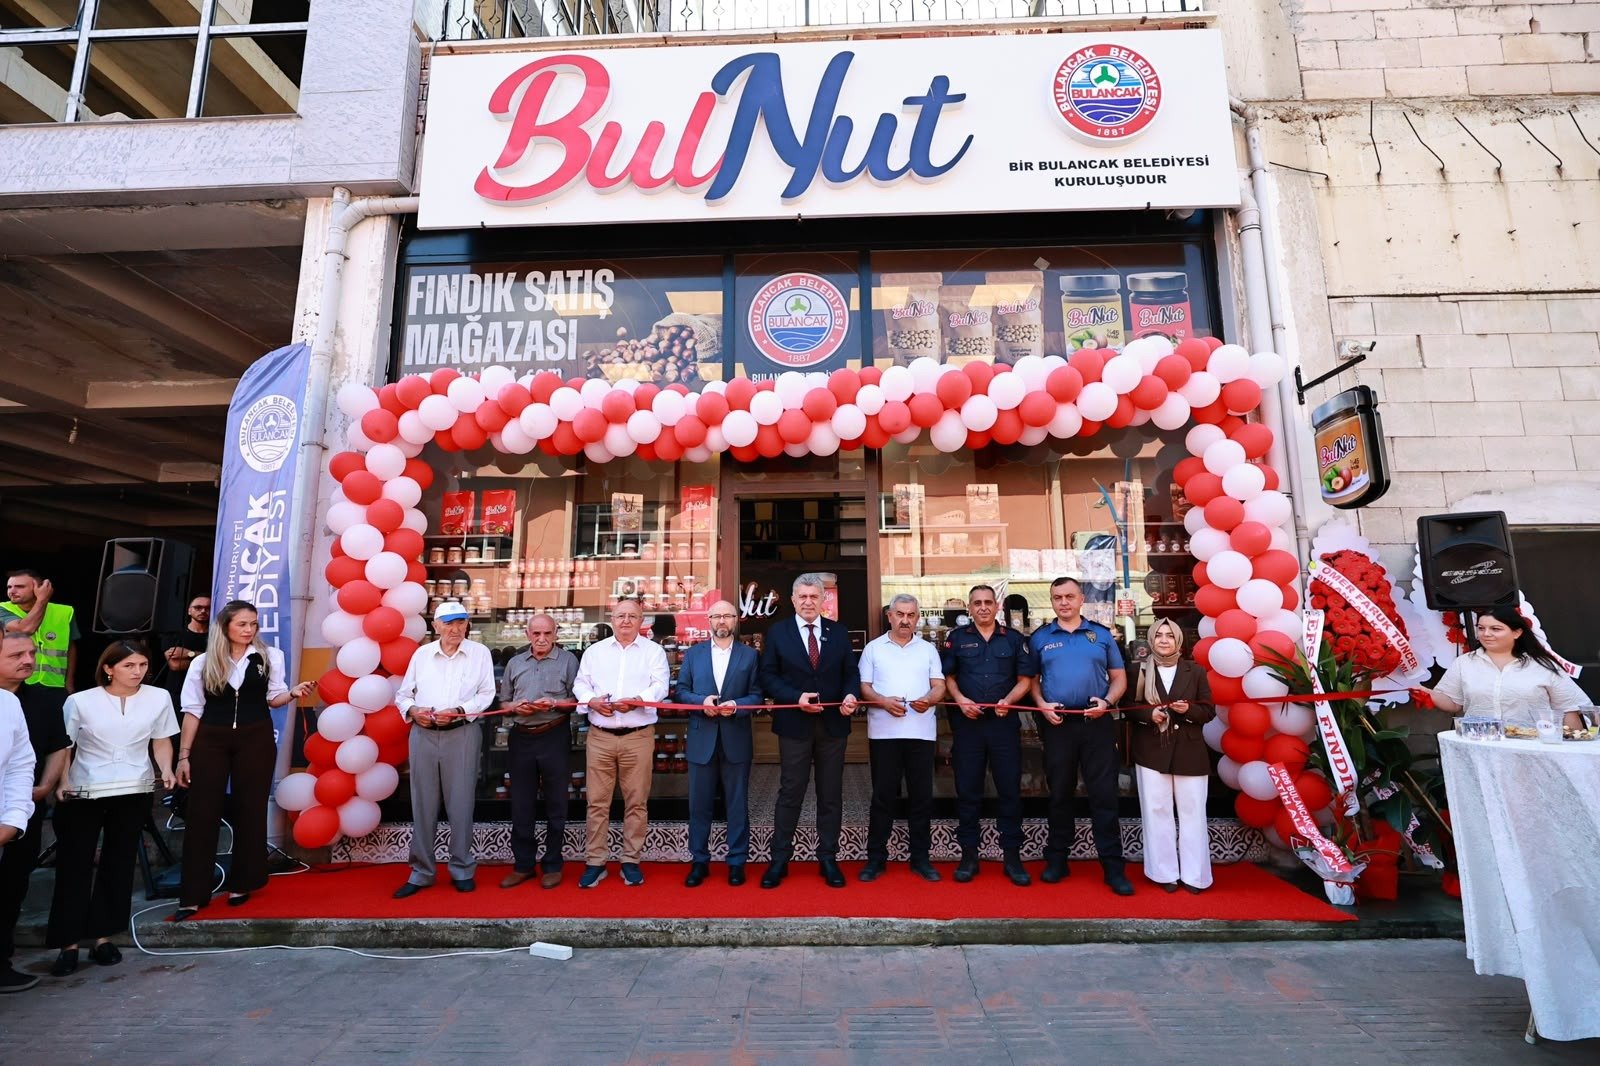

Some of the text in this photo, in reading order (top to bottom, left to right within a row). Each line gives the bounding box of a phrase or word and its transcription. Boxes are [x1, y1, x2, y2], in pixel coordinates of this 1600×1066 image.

[1055, 47, 1098, 112] BULANCAK
[1071, 86, 1142, 99] BULANCAK
[473, 50, 976, 206] BulNut
[1096, 127, 1126, 136] 1887
[1008, 154, 1210, 171] BİR BULANCAK BELEDİYESİ
[1054, 174, 1168, 188] KURULUŞUDUR
[407, 268, 616, 319] FINDIK SATIŞ
[753, 278, 793, 332] BULANCAK
[892, 299, 935, 320] BulNut
[768, 315, 828, 327] BULANCAK
[949, 310, 989, 328] BulNut
[1067, 304, 1119, 328] BulNut
[1138, 304, 1185, 328] BulNut
[404, 314, 577, 366] MAĞAZASI
[787, 353, 811, 363] 1887
[241, 399, 268, 446] BULANCAK
[225, 519, 244, 603] UMHURİYETİ
[238, 491, 270, 603] NCAK
[740, 583, 778, 619] Nut
[1355, 593, 1393, 631] FARUK
[1286, 784, 1313, 826] BULANCAK
